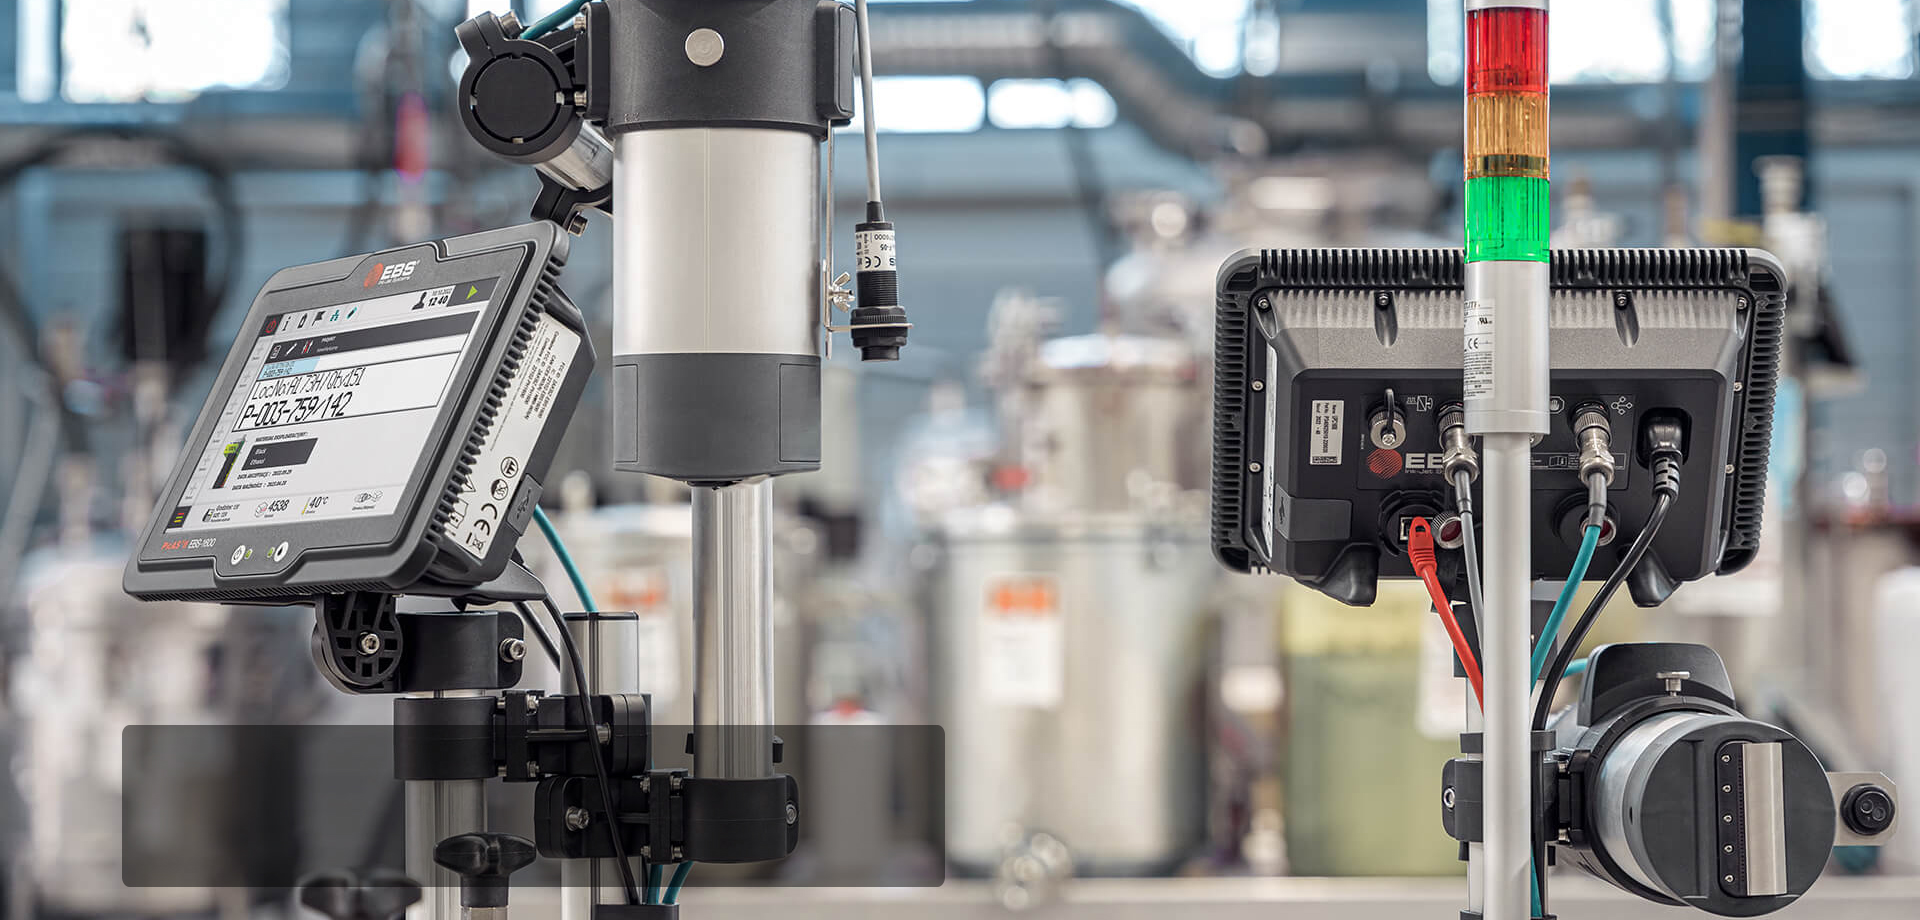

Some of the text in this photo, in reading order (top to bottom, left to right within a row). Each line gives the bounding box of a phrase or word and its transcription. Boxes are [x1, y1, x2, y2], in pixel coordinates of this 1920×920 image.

[380, 260, 417, 280] EBS
[238, 391, 353, 429] P-003-759/142
[268, 499, 290, 512] 4538
